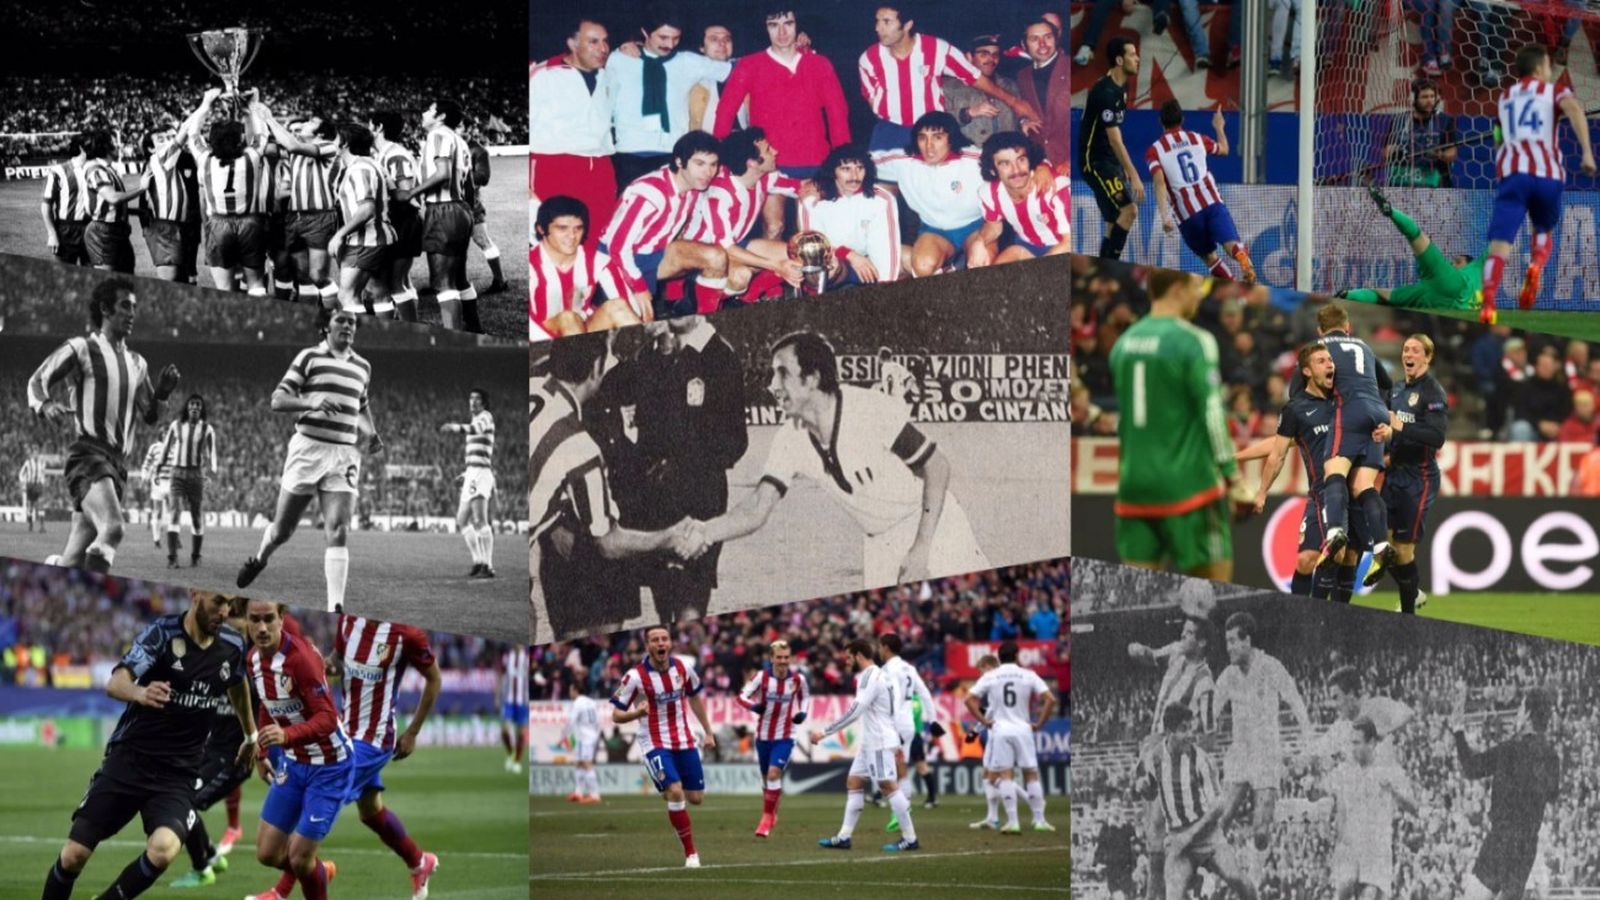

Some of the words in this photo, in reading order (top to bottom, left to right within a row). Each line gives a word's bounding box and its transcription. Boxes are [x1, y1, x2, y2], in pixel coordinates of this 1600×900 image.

[1504, 99, 1542, 139] 14
[1177, 150, 1200, 184] 6
[1106, 176, 1123, 193] 16
[1340, 343, 1364, 375] 7
[1133, 361, 1146, 427] 1
[979, 401, 1071, 421] CINZAN
[1431, 511, 1600, 596] pe
[1003, 682, 1017, 708] 6
[651, 755, 664, 773] 17
